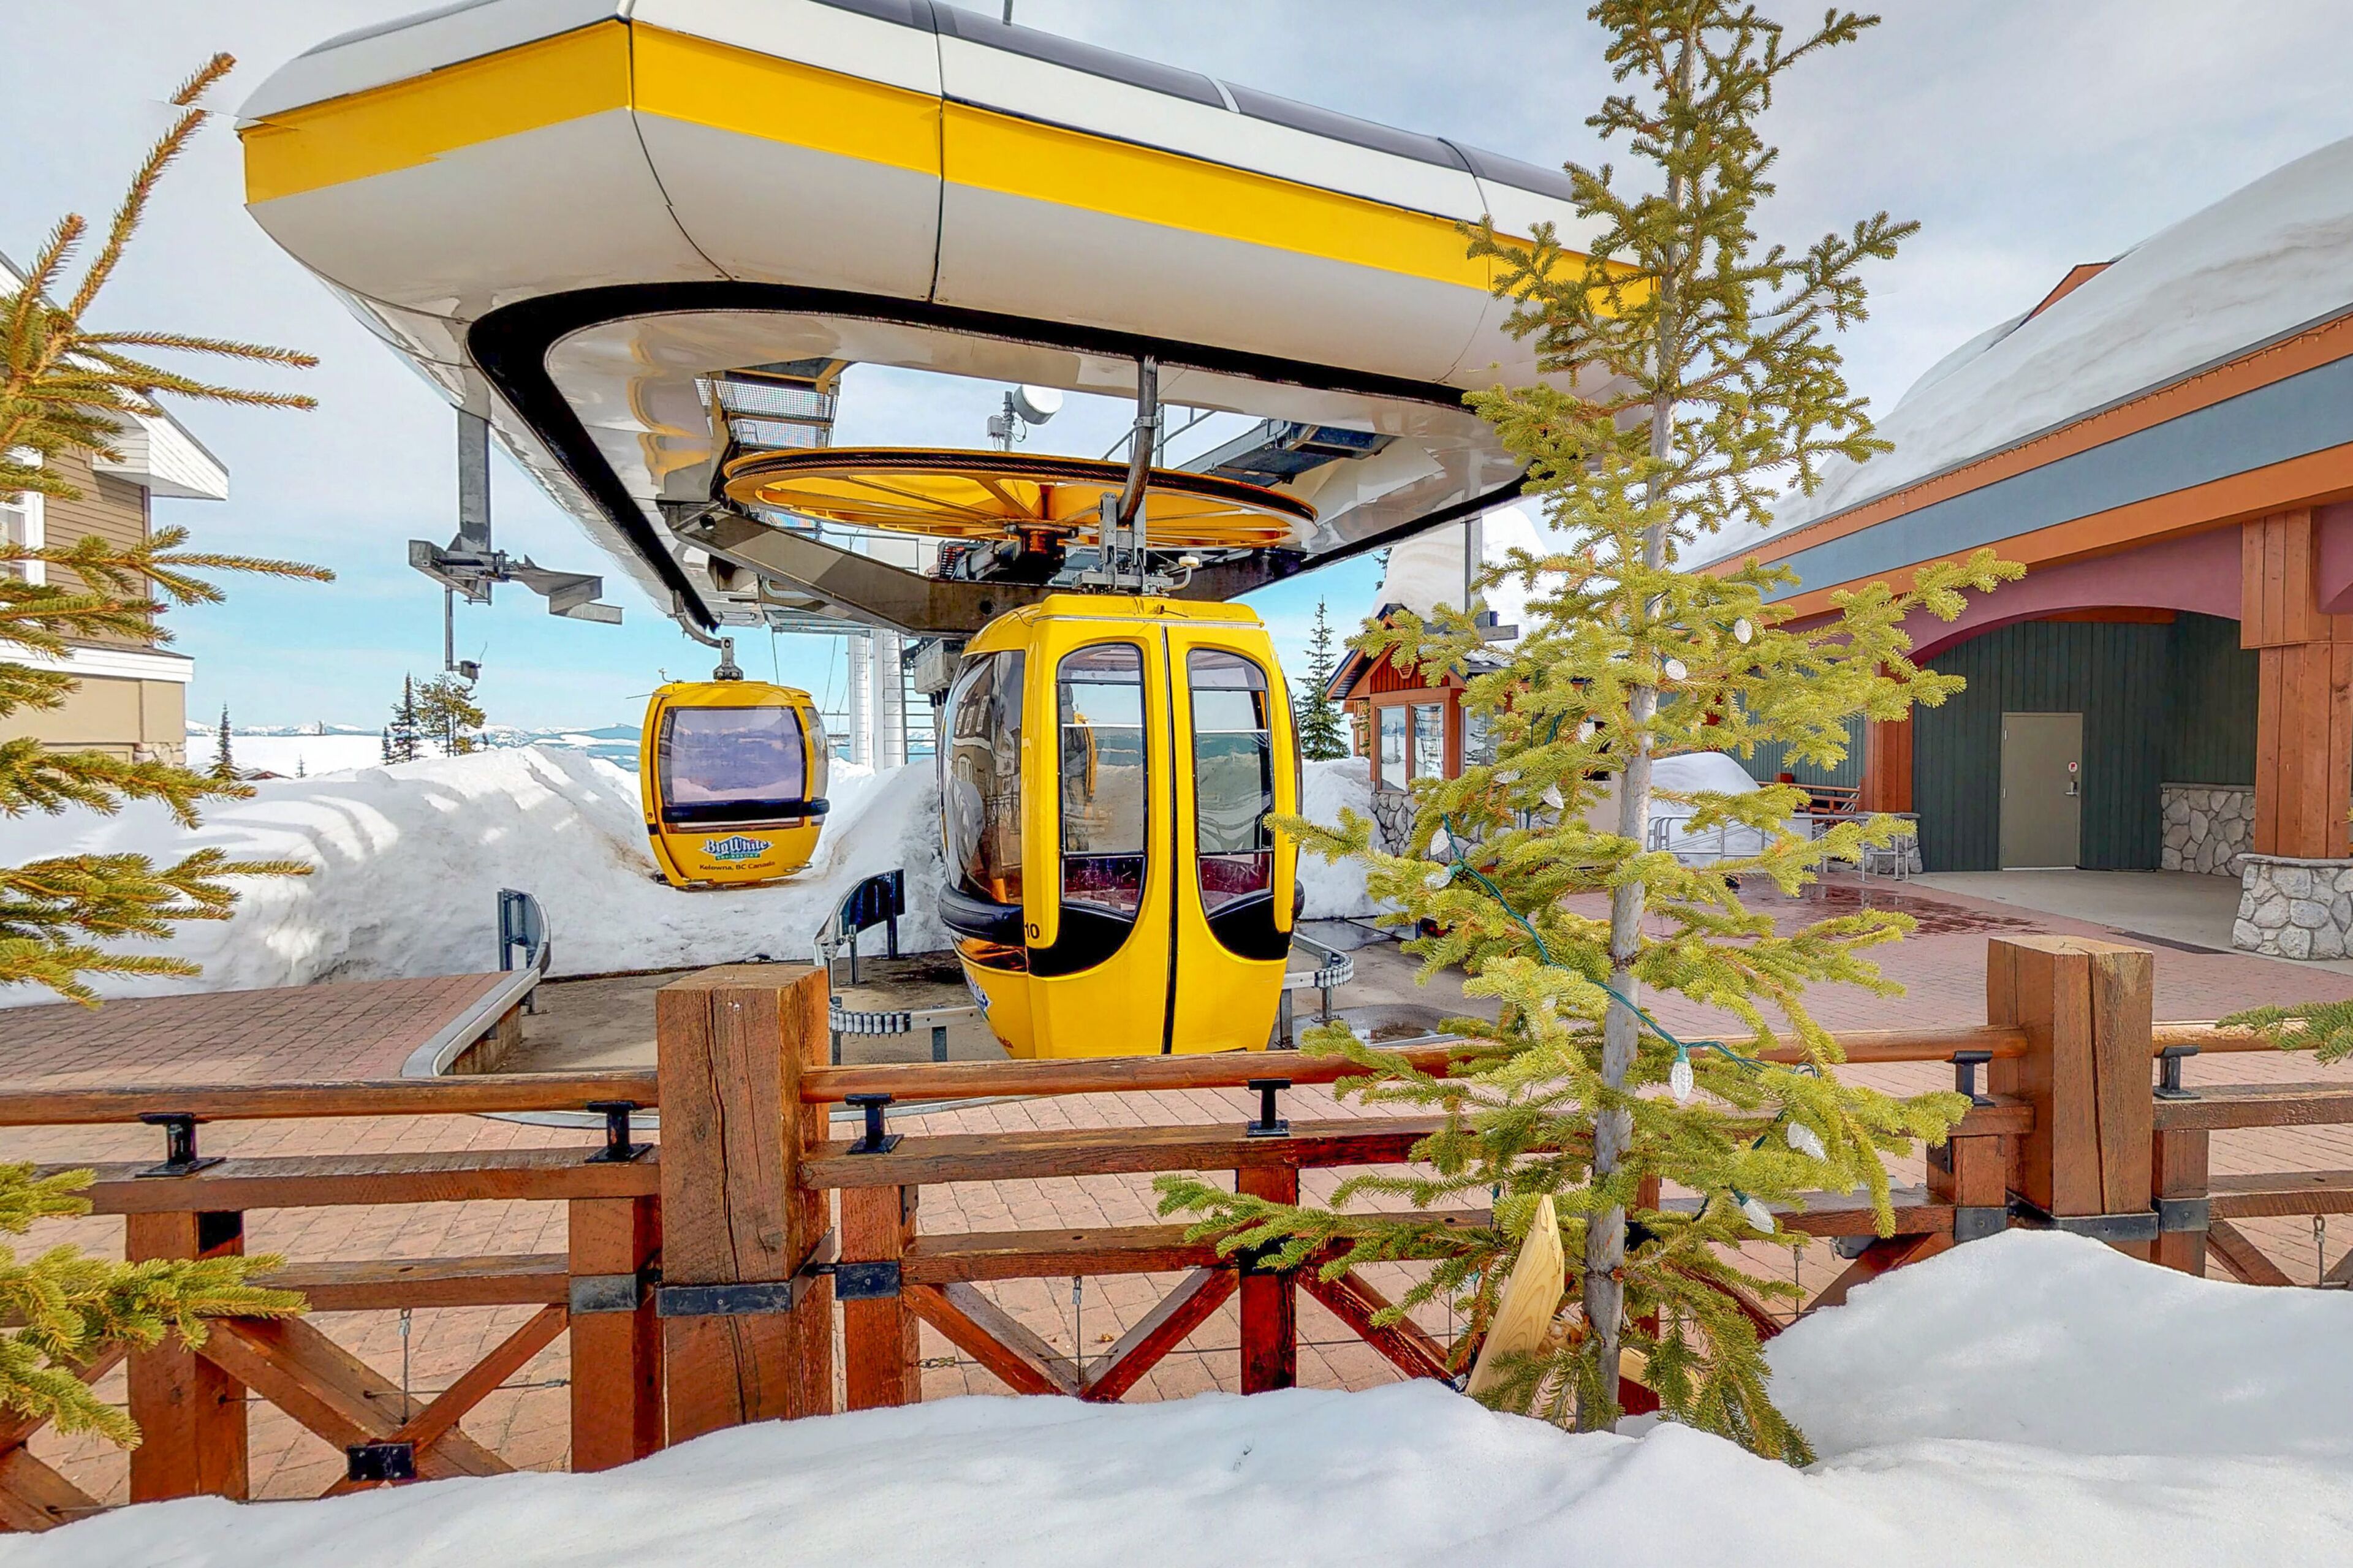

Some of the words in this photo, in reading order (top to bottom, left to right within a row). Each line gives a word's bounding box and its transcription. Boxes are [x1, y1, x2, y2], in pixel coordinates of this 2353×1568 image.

[705, 839, 729, 854] Big
[729, 838, 768, 852] White
[748, 860, 775, 869] Canada
[1025, 922, 1040, 939] 10
